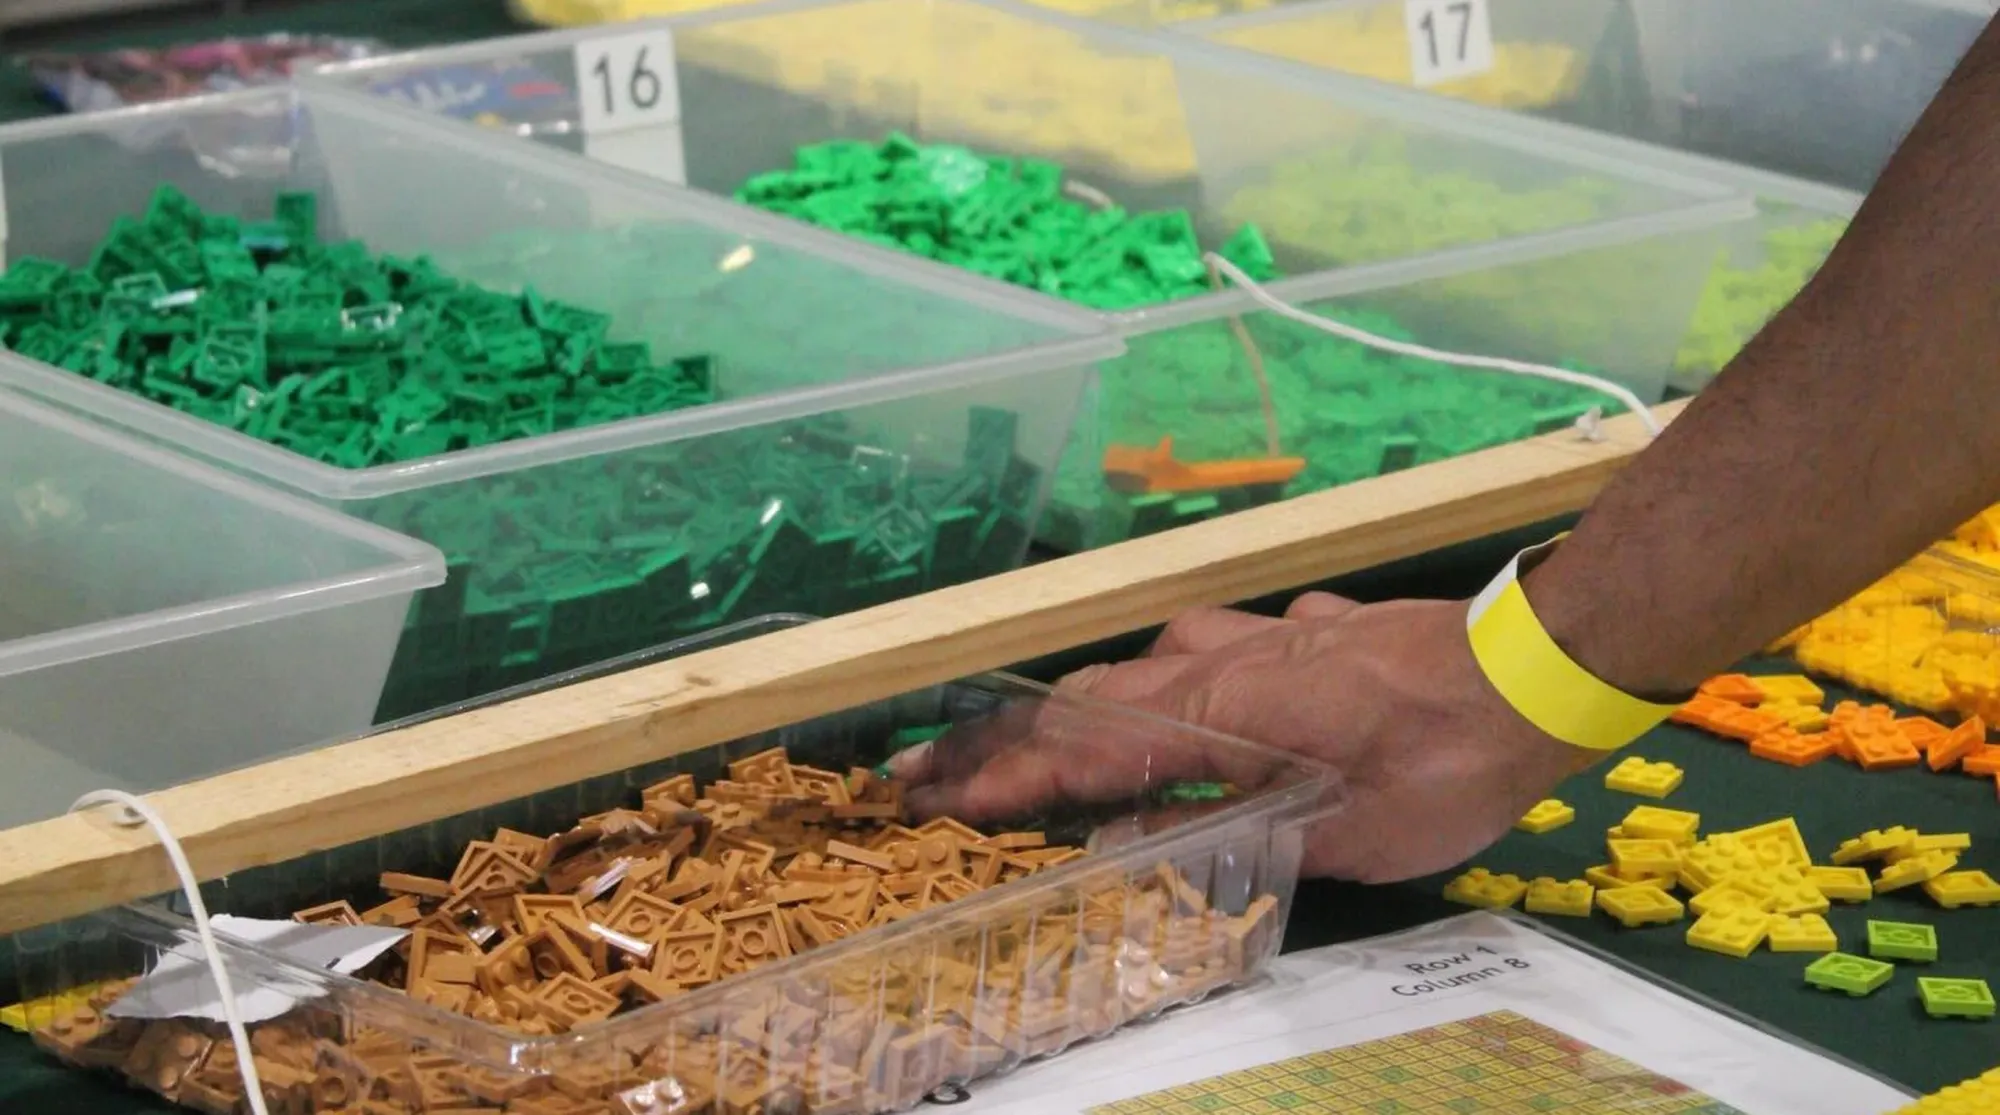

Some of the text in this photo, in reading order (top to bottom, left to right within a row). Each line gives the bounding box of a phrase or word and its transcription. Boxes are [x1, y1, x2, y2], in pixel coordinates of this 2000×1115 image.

[1419, 3, 1470, 67] 17
[593, 45, 661, 116] 16
[1391, 957, 1531, 997] Column 8
[1404, 945, 1498, 975] Row 1
